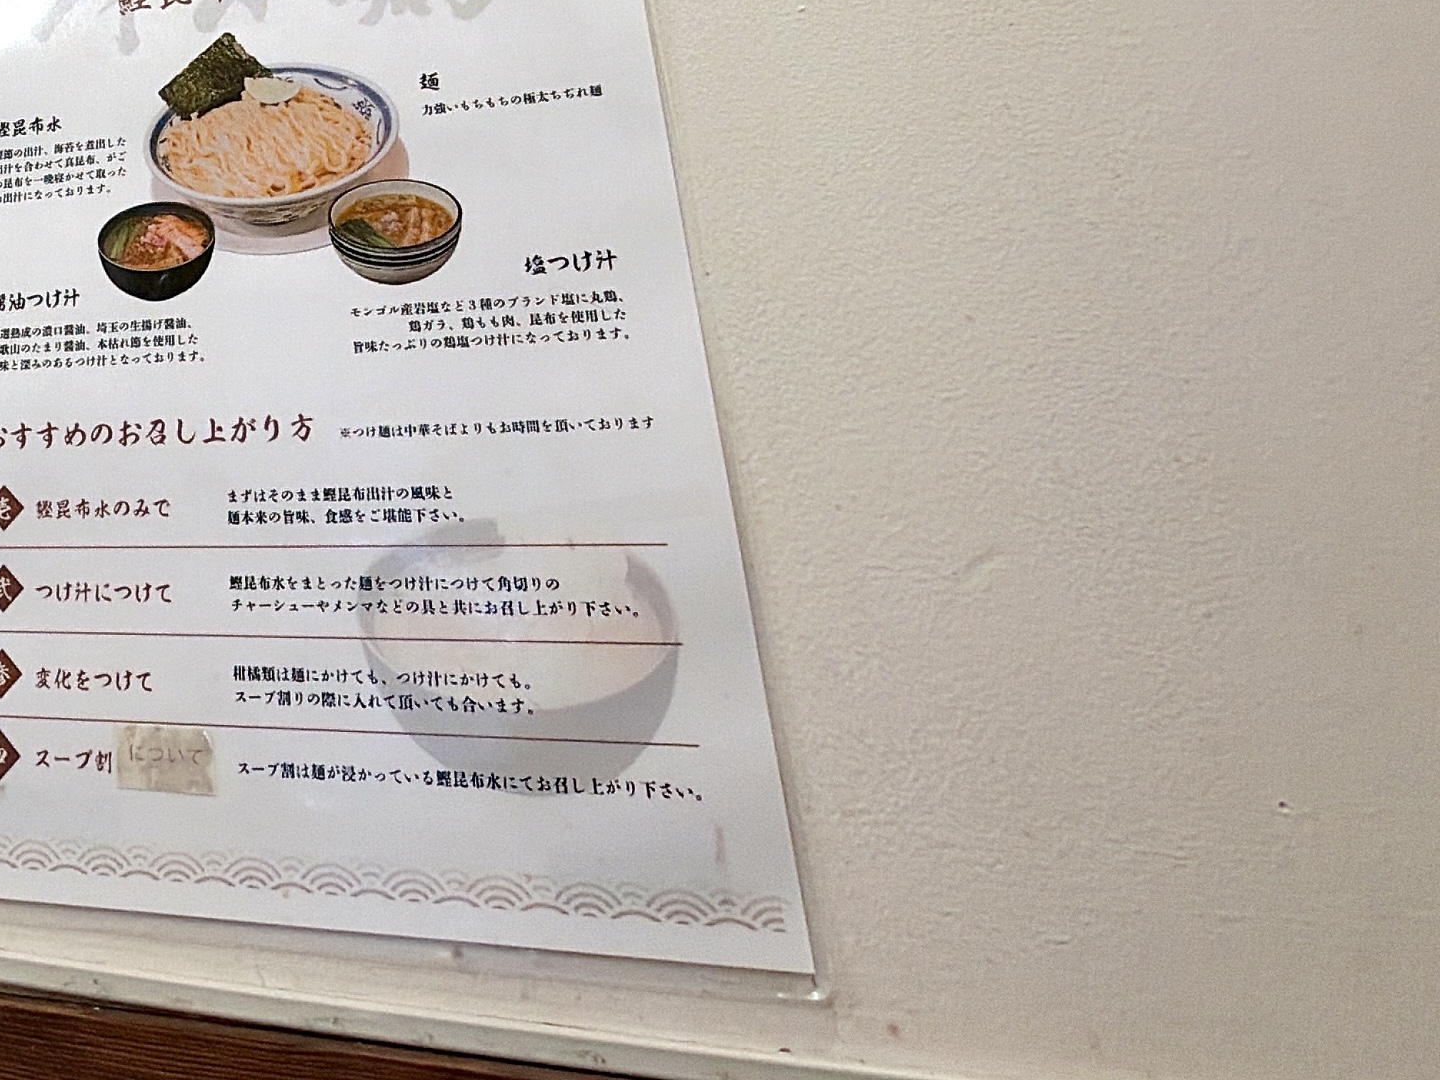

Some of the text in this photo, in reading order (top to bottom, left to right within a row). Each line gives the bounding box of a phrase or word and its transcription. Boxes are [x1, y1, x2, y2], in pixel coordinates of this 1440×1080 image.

[419, 72, 440, 91] 麺
[422, 84, 603, 116] 力強いもちもちの極太ちぢれ麺
[524, 249, 617, 275] 塩つけ汁
[409, 309, 626, 332] 鶏ガラ、鶏もも肉、昆布を使用した
[353, 328, 630, 353] 旨味たっぷりの鶏塩つけ汁になっております。
[227, 485, 453, 503] まずはそのまま鰹昆布出汁の風味と
[35, 498, 171, 520] 鰹昆布水のみで
[227, 508, 465, 525] 麺本来の旨味、食感をご堪能下さい。
[36, 581, 172, 603] つけ汁につけて
[229, 575, 560, 592] 鰹昆布水をまとった麺をつけ汁につけて角切りの
[231, 599, 639, 618] チャーシューやメンマなどの具と共にお召し上がり下さい。
[35, 667, 153, 692] 変化をつけて
[233, 665, 531, 690] 柑橘類は麺にかけても、つけ汁にかけても。
[235, 690, 534, 715] スープ割りの際に入れて頂いても合います。
[35, 749, 112, 774] スープ割
[238, 761, 702, 800] スープ割は麺が浸かっている鰹昆布水にてお召し上がり下さい。
